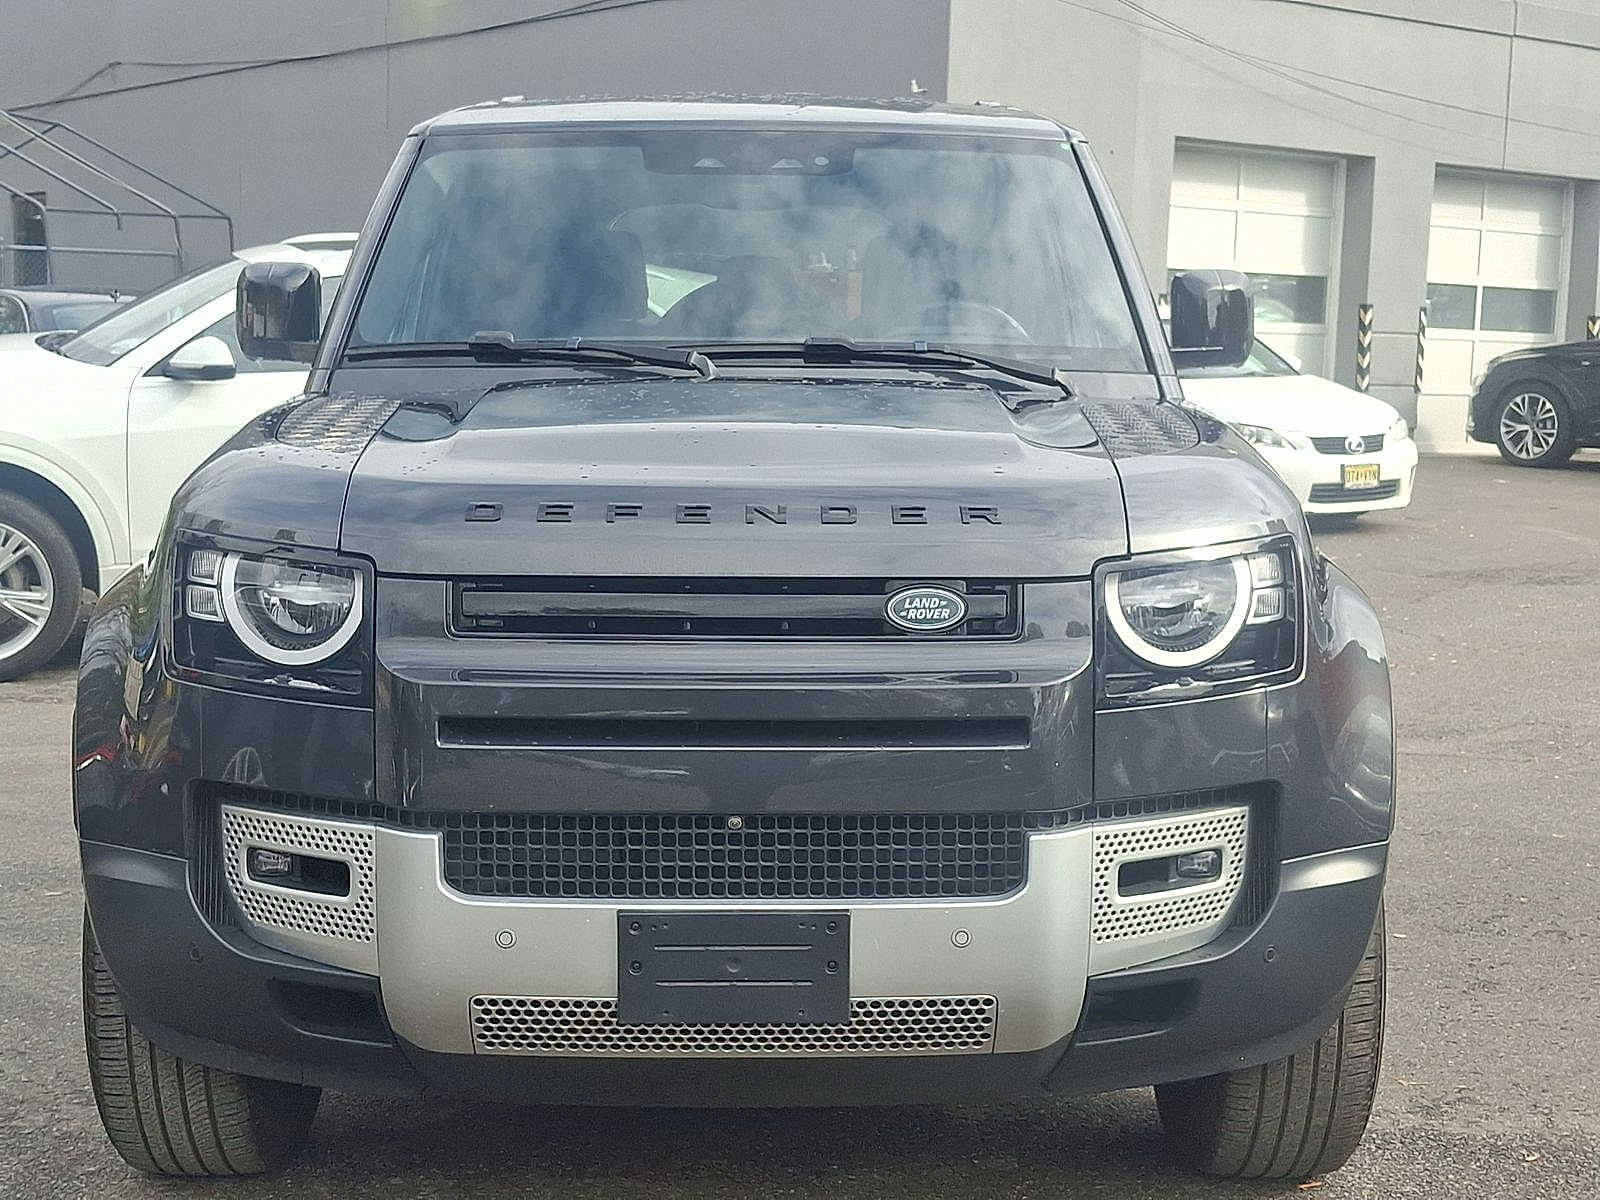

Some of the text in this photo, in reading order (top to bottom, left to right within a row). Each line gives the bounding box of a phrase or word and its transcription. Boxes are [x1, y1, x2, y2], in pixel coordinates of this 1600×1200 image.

[464, 501, 1004, 525] DEFENDER
[904, 597, 940, 609] LAND
[907, 608, 950, 620] ROVER
